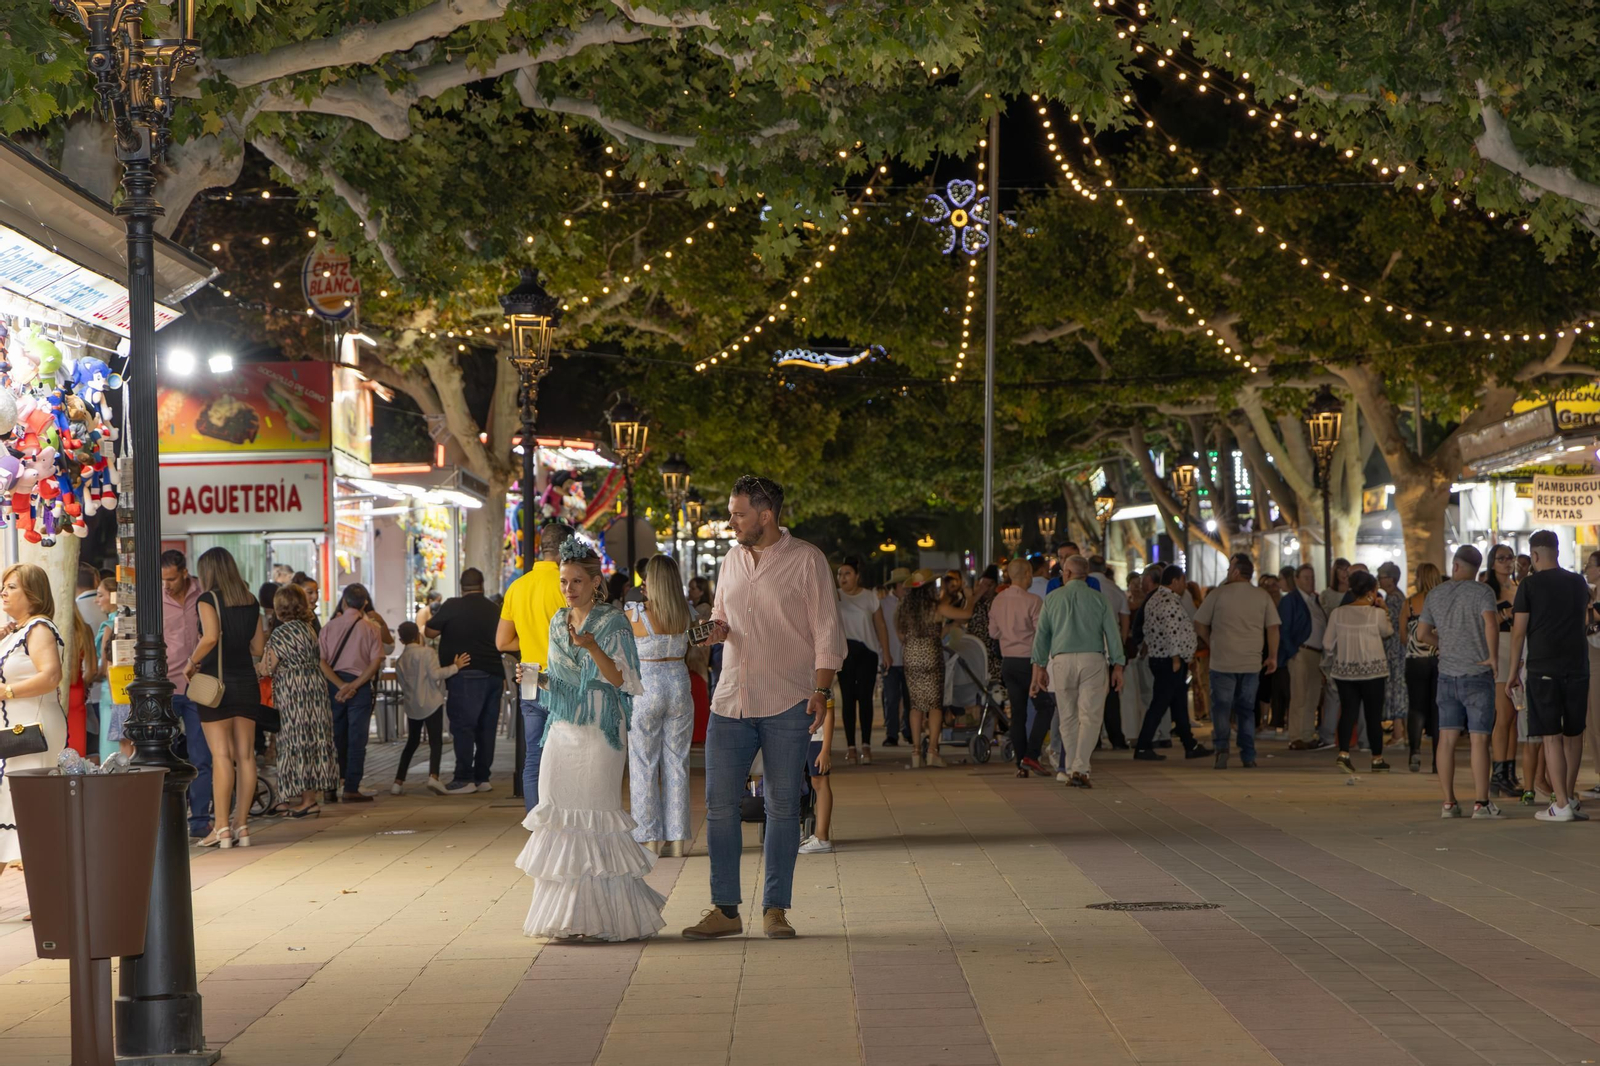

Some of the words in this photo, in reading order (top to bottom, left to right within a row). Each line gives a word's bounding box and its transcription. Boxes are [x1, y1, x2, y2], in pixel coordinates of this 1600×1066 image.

[313, 262, 349, 277] CRUZ
[310, 277, 360, 296] BLANCA
[168, 478, 302, 515] BAGUETERÍA
[1537, 494, 1593, 506] REFRESCO
[1537, 508, 1583, 519] PATATAS
